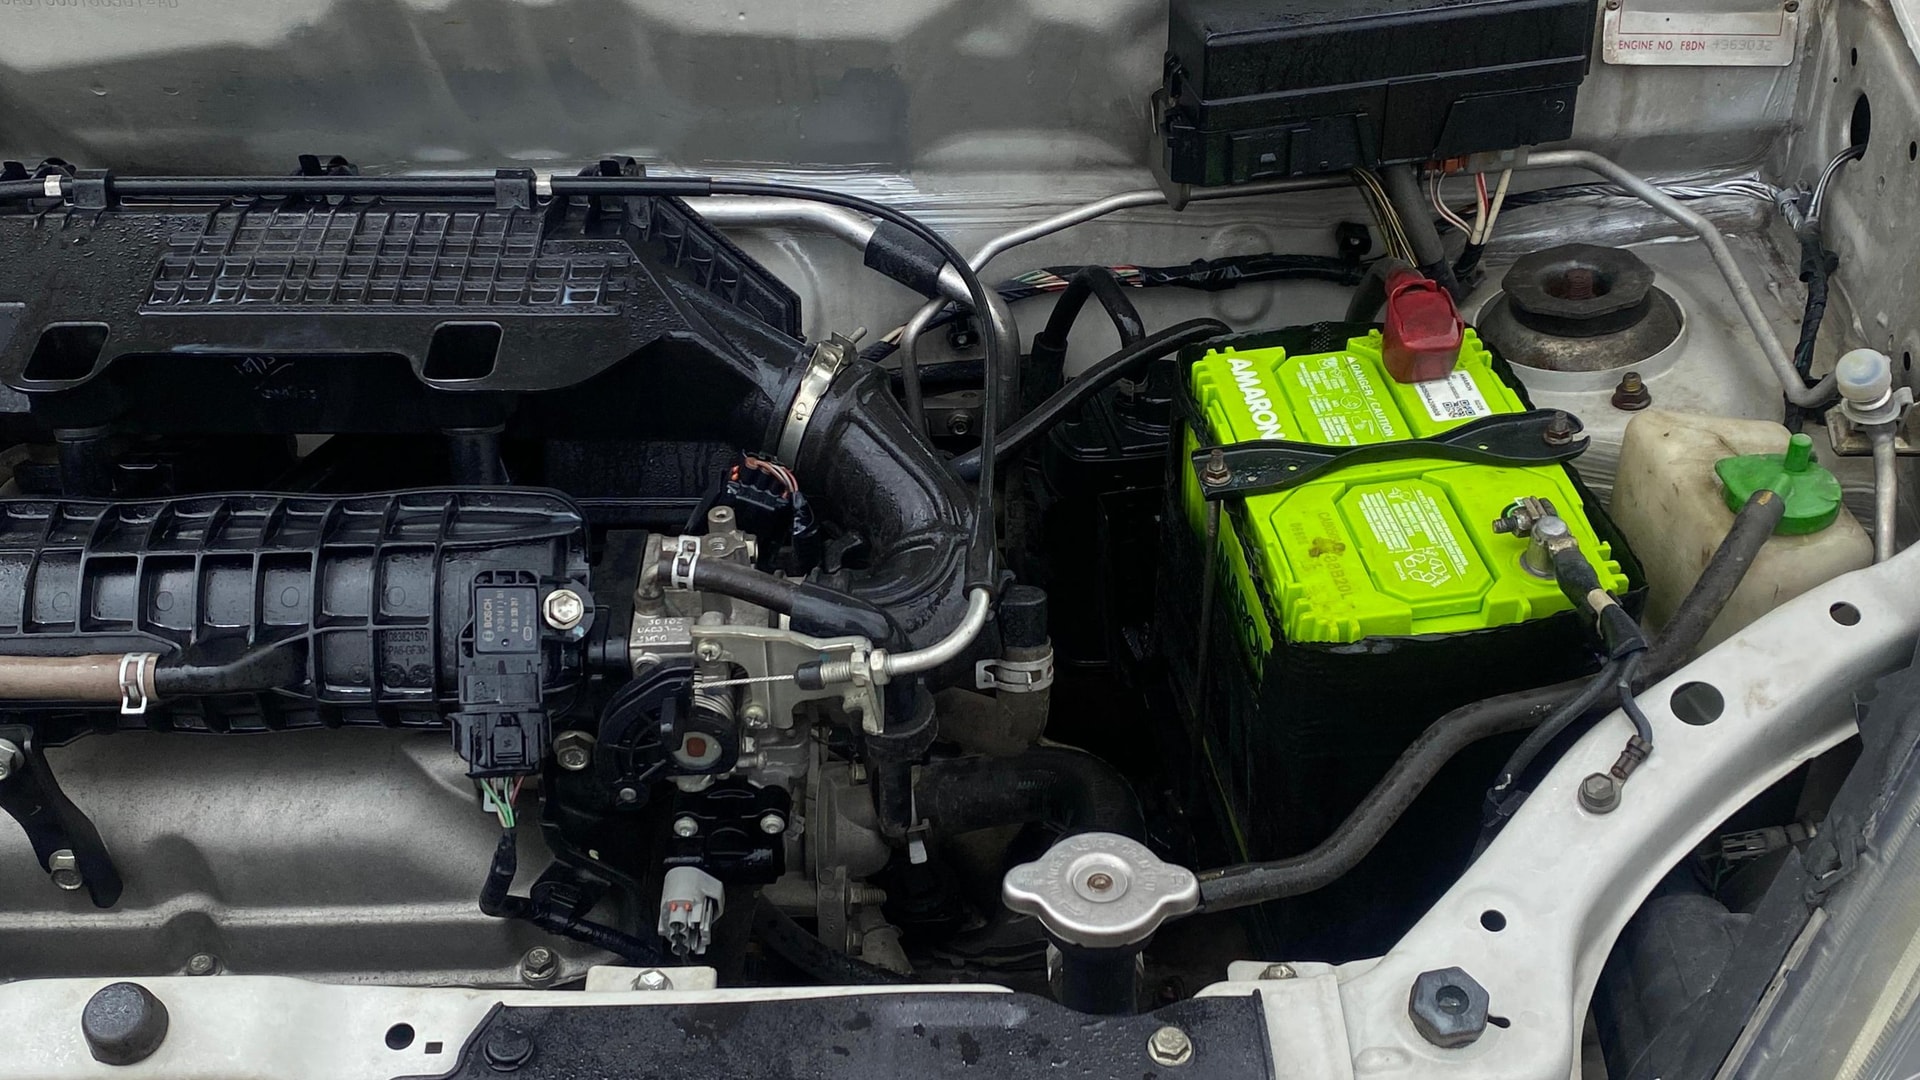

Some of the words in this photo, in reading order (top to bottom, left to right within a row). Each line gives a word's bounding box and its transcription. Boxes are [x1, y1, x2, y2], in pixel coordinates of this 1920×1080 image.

[1618, 40, 1654, 51] ENGINE
[1680, 40, 1706, 51] F8DN
[1226, 358, 1286, 440] AMARON
[1352, 364, 1374, 396] DANGER
[1370, 402, 1396, 437] CAUTION
[483, 598, 492, 628] BOSCH
